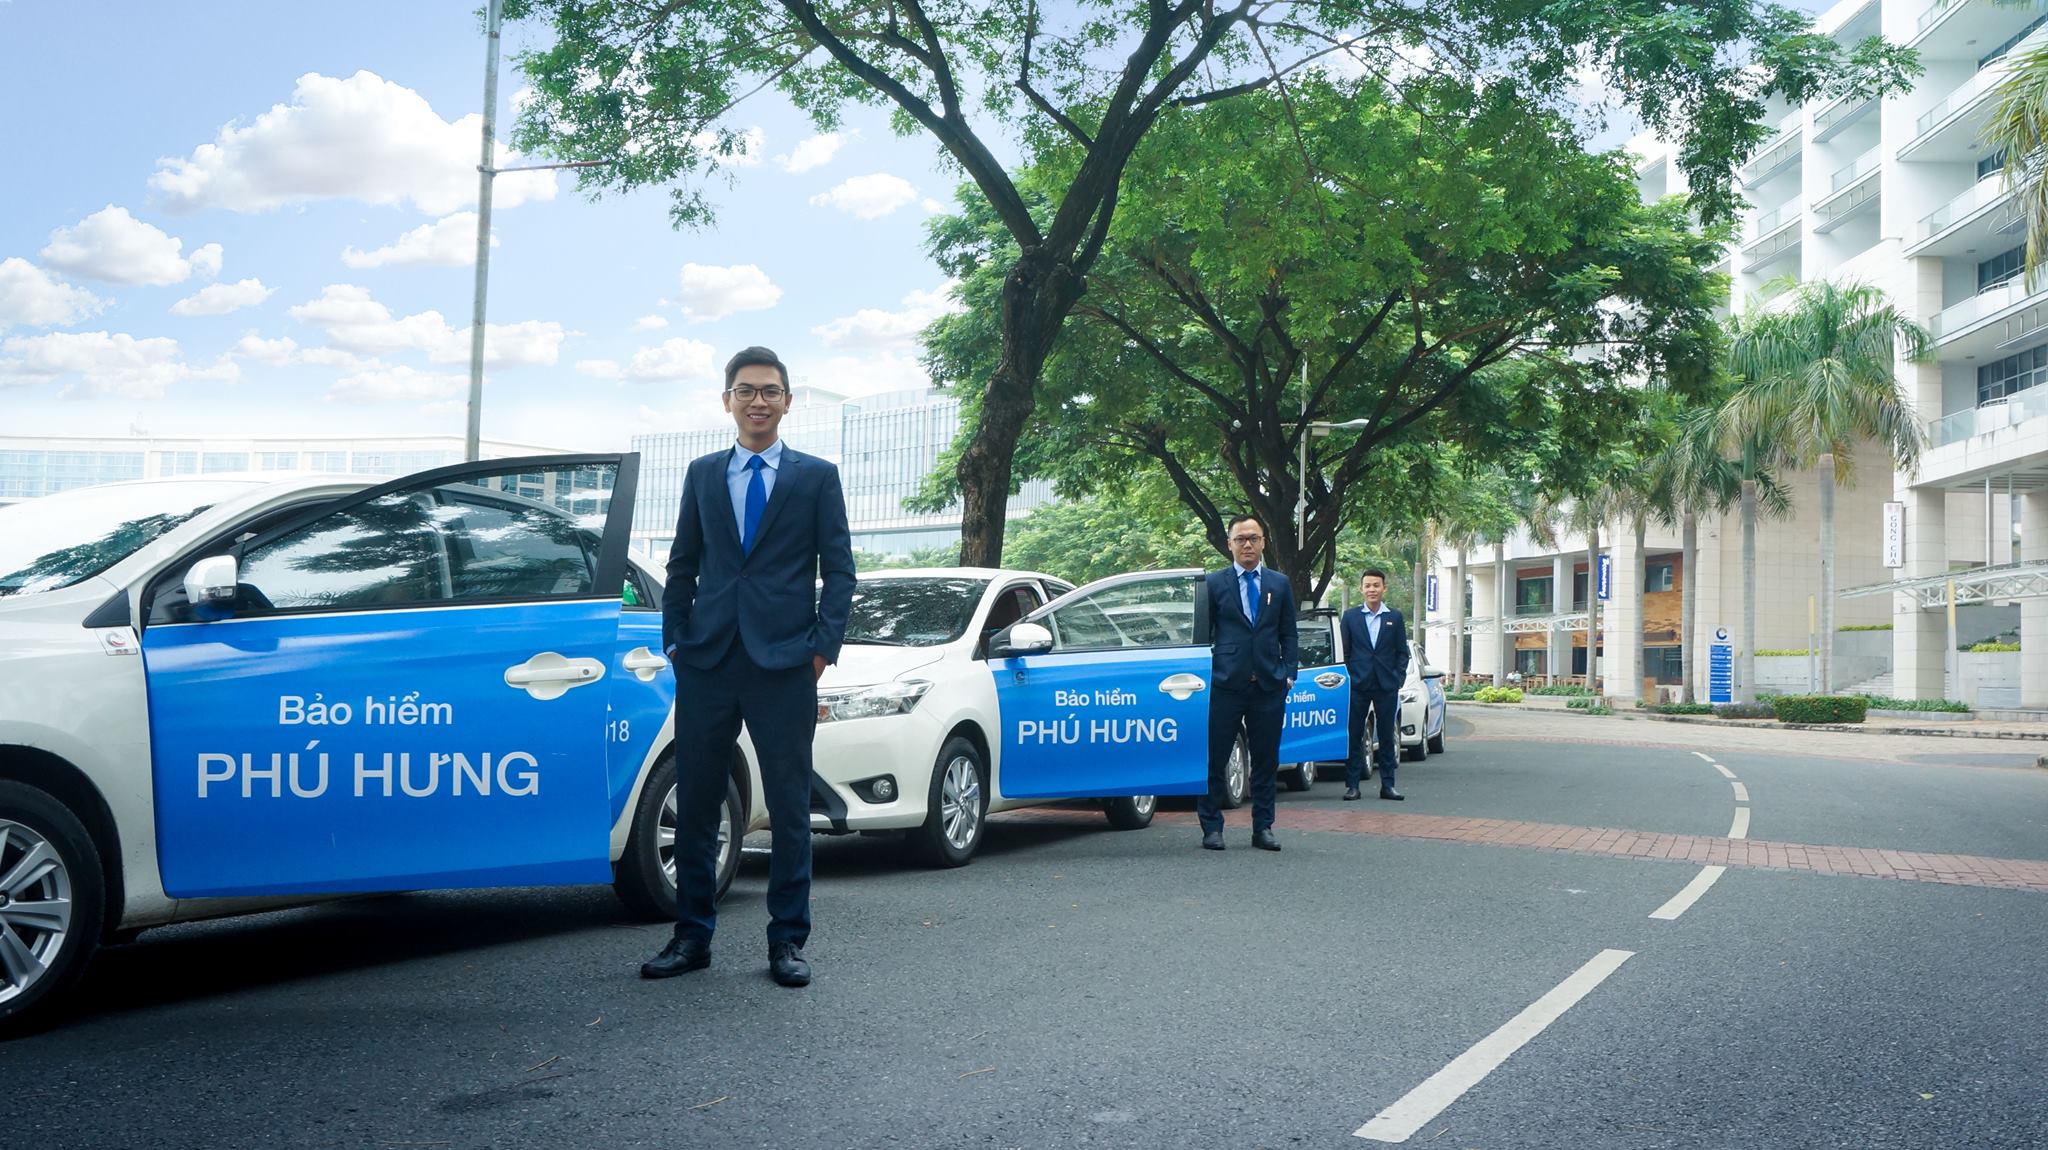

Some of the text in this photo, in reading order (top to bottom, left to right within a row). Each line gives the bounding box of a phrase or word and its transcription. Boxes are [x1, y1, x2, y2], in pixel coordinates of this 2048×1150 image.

[1889, 515, 1898, 541] GONG
[1889, 545, 1898, 565] CHA
[278, 691, 453, 726] Bảo hiểm
[1055, 688, 1137, 707] Bảo hiểm
[1018, 713, 1178, 745] PHÚ HƯNG
[1291, 708, 1337, 729] HƯNG
[605, 720, 630, 742] 18
[197, 740, 540, 798] PHÚ HƯNG
